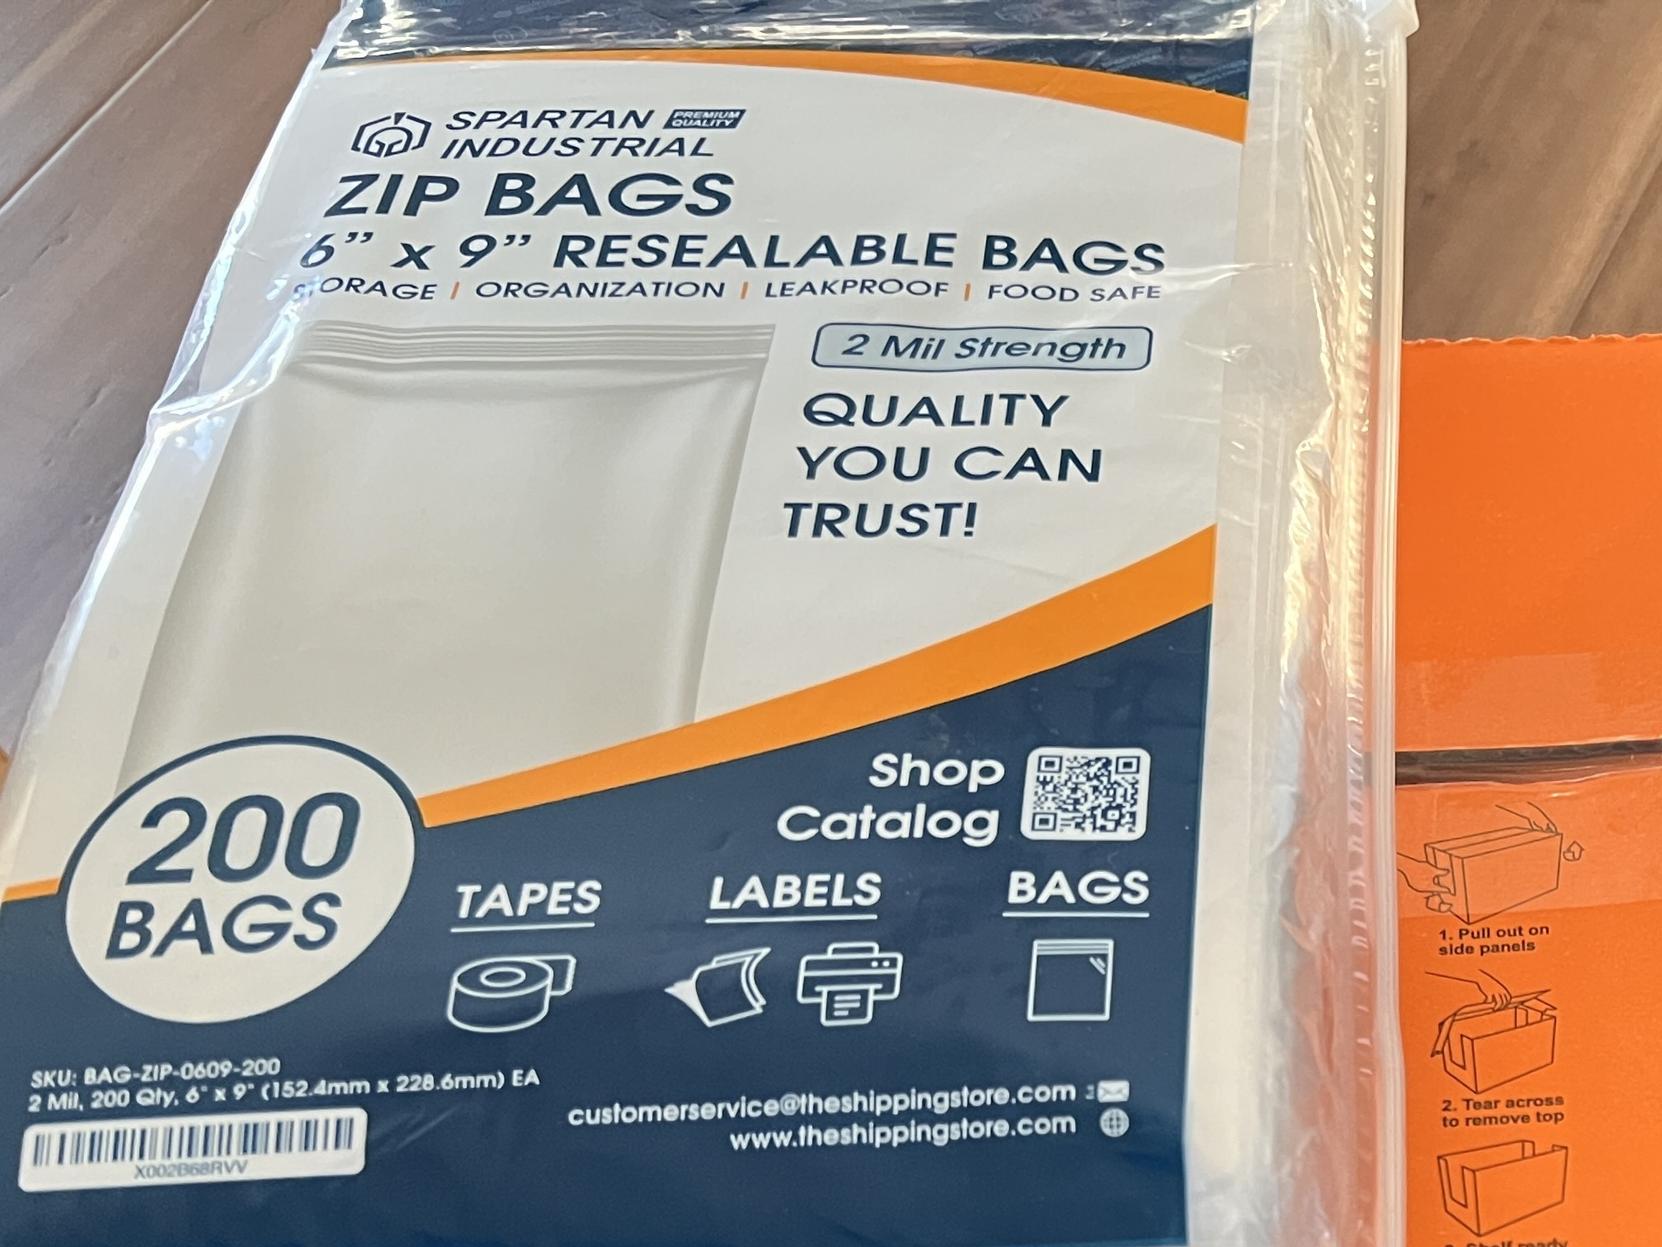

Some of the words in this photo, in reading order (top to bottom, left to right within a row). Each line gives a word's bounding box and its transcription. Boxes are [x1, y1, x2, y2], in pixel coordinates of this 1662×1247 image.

[446, 109, 654, 130] SPARTAN
[672, 119, 734, 127] QUALITY
[673, 111, 741, 119] PREMIUM
[440, 137, 714, 160] INDUSTRIAL
[323, 173, 461, 217] ZIP
[484, 172, 735, 217] BAGS
[390, 243, 436, 270] x
[553, 232, 957, 269] RESEALABLE
[981, 234, 1166, 276] BAGS
[293, 277, 437, 300] ORAGE
[475, 280, 725, 300] ORGANIZATION
[764, 278, 949, 299] LEAKPROOF
[987, 283, 1079, 303] FOOD
[1090, 285, 1162, 303] SAFE
[841, 333, 870, 357] 2
[882, 334, 946, 361] Mil
[954, 337, 1127, 364] Strength
[802, 393, 1071, 427] QUALITY
[796, 446, 931, 482] YOU
[953, 447, 1102, 483] CAN
[783, 502, 978, 539] TRUST!
[868, 752, 1005, 793] Shop
[125, 792, 361, 886] 200
[776, 804, 1000, 847] Catalog
[456, 880, 602, 919] TAPES
[710, 872, 882, 910] LABELS
[1007, 870, 1150, 905] BAGS
[105, 892, 343, 960] BAGS
[1439, 930, 1453, 941] 1.
[1458, 927, 1491, 940] Pull
[1496, 926, 1523, 938] out
[1529, 926, 1550, 936] on
[1439, 943, 1474, 956] side
[1480, 940, 1536, 957] panels
[28, 1095, 41, 1112] 2
[90, 1089, 130, 1108] 200
[215, 1088, 226, 1102] x
[261, 1079, 370, 1101] (152.4mm
[376, 1080, 390, 1093] x
[396, 1071, 505, 1093] 228.6mm)
[512, 1069, 541, 1087] EA
[31, 1070, 77, 1089] SKU:
[84, 1058, 281, 1085] BAG-ZIP-0609-200
[567, 1082, 1076, 1126] customerservice@theshippingstore.com
[1442, 1099, 1458, 1112] 2.
[1462, 1098, 1501, 1110] Tear
[1505, 1095, 1565, 1109] across
[1442, 1115, 1459, 1127] to
[1464, 1113, 1532, 1126] remove
[1536, 1110, 1565, 1127] top
[730, 1112, 1076, 1150] www.theshippingstore.com
